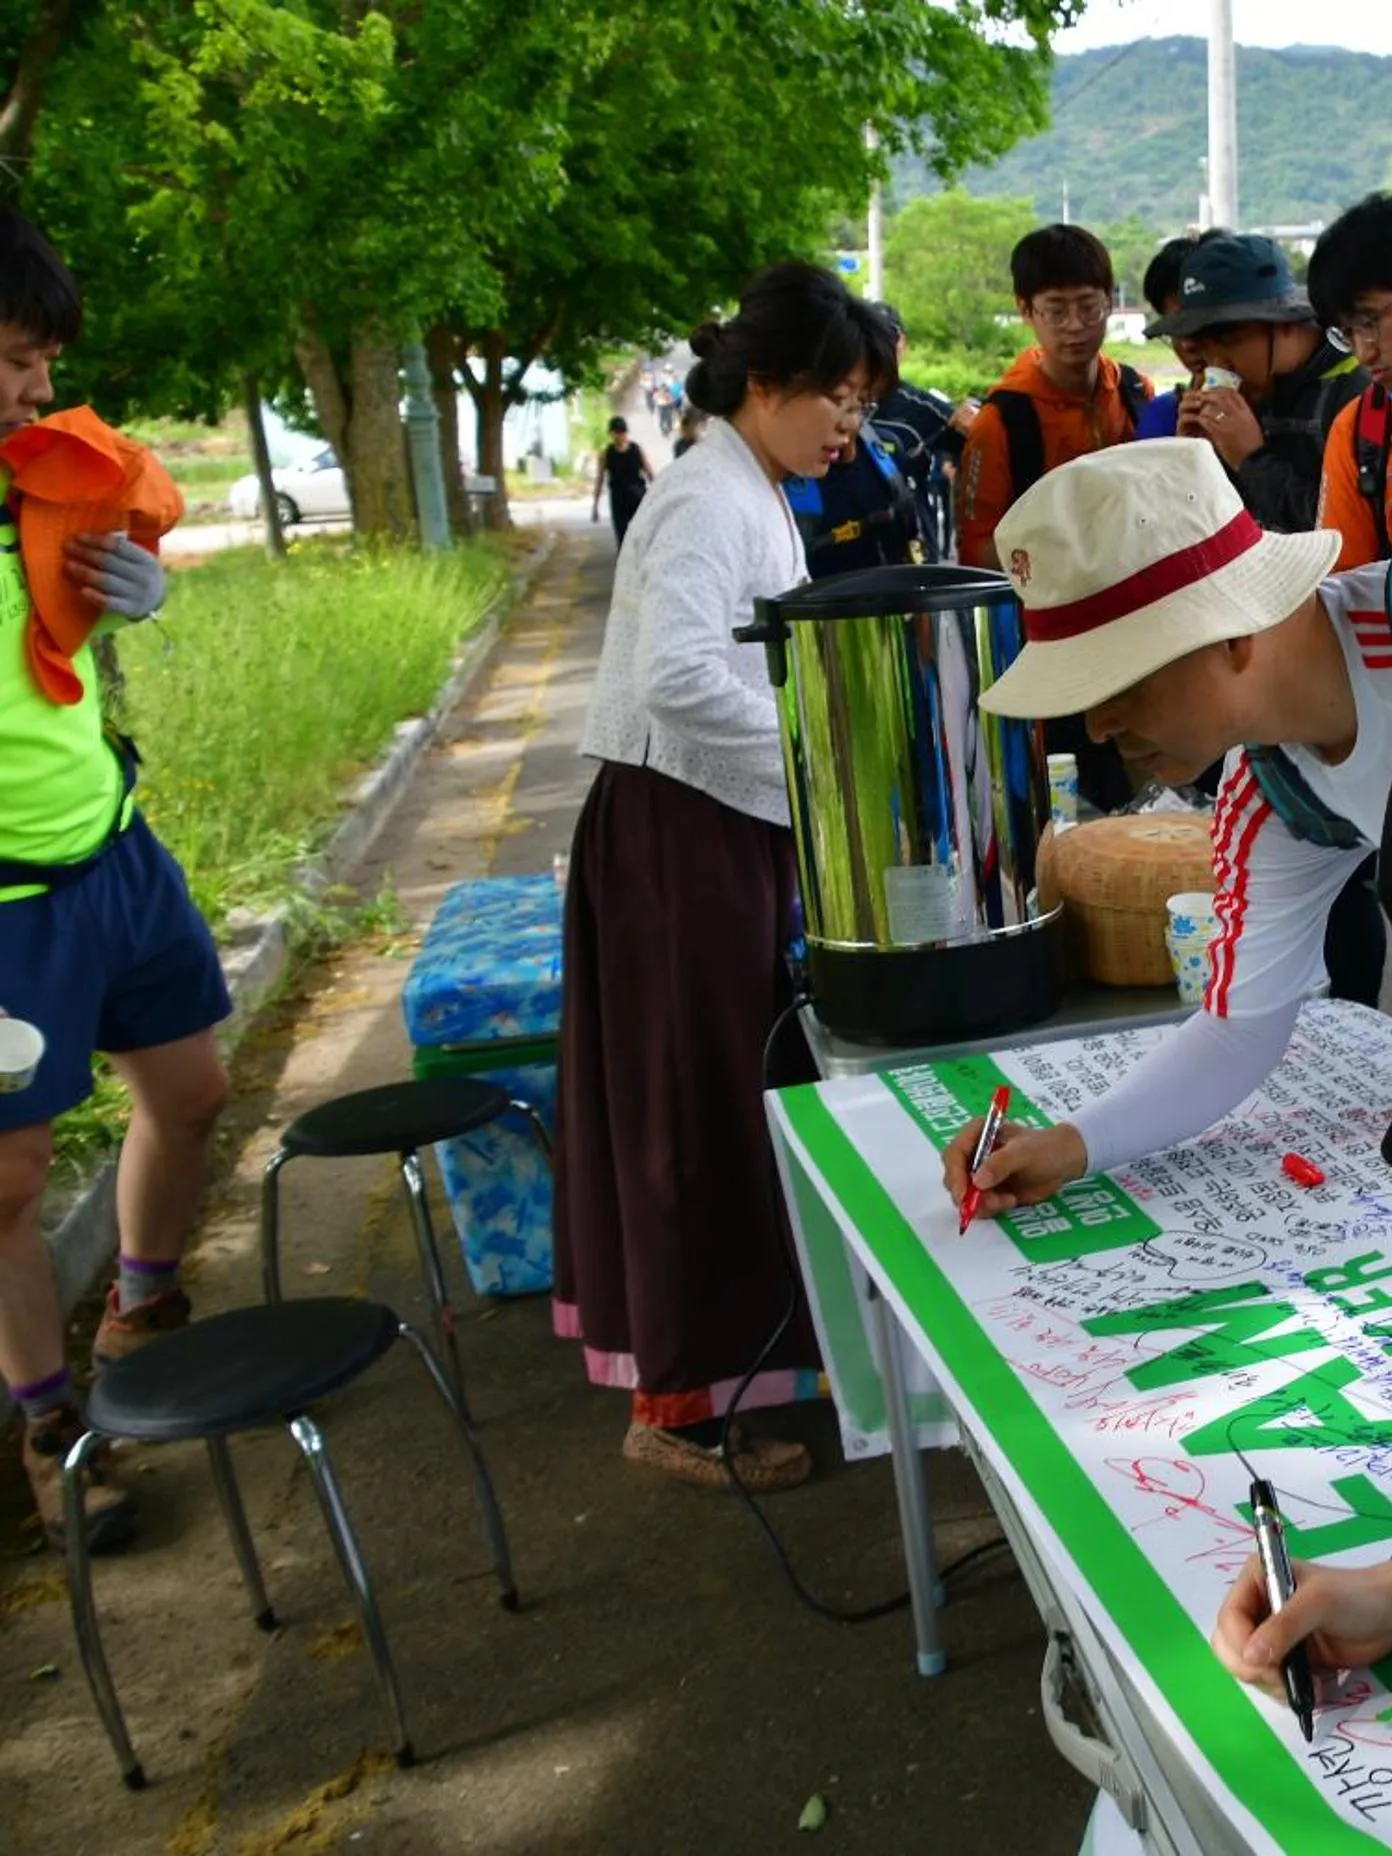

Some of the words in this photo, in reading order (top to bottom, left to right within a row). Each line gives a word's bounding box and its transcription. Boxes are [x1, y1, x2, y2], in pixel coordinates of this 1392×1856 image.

[1215, 1157, 1266, 1180] 시간
[1194, 1176, 1272, 1223] 완주하는
[1242, 1179, 1307, 1213] 지정된
[1168, 1197, 1230, 1233] 옥스팜
